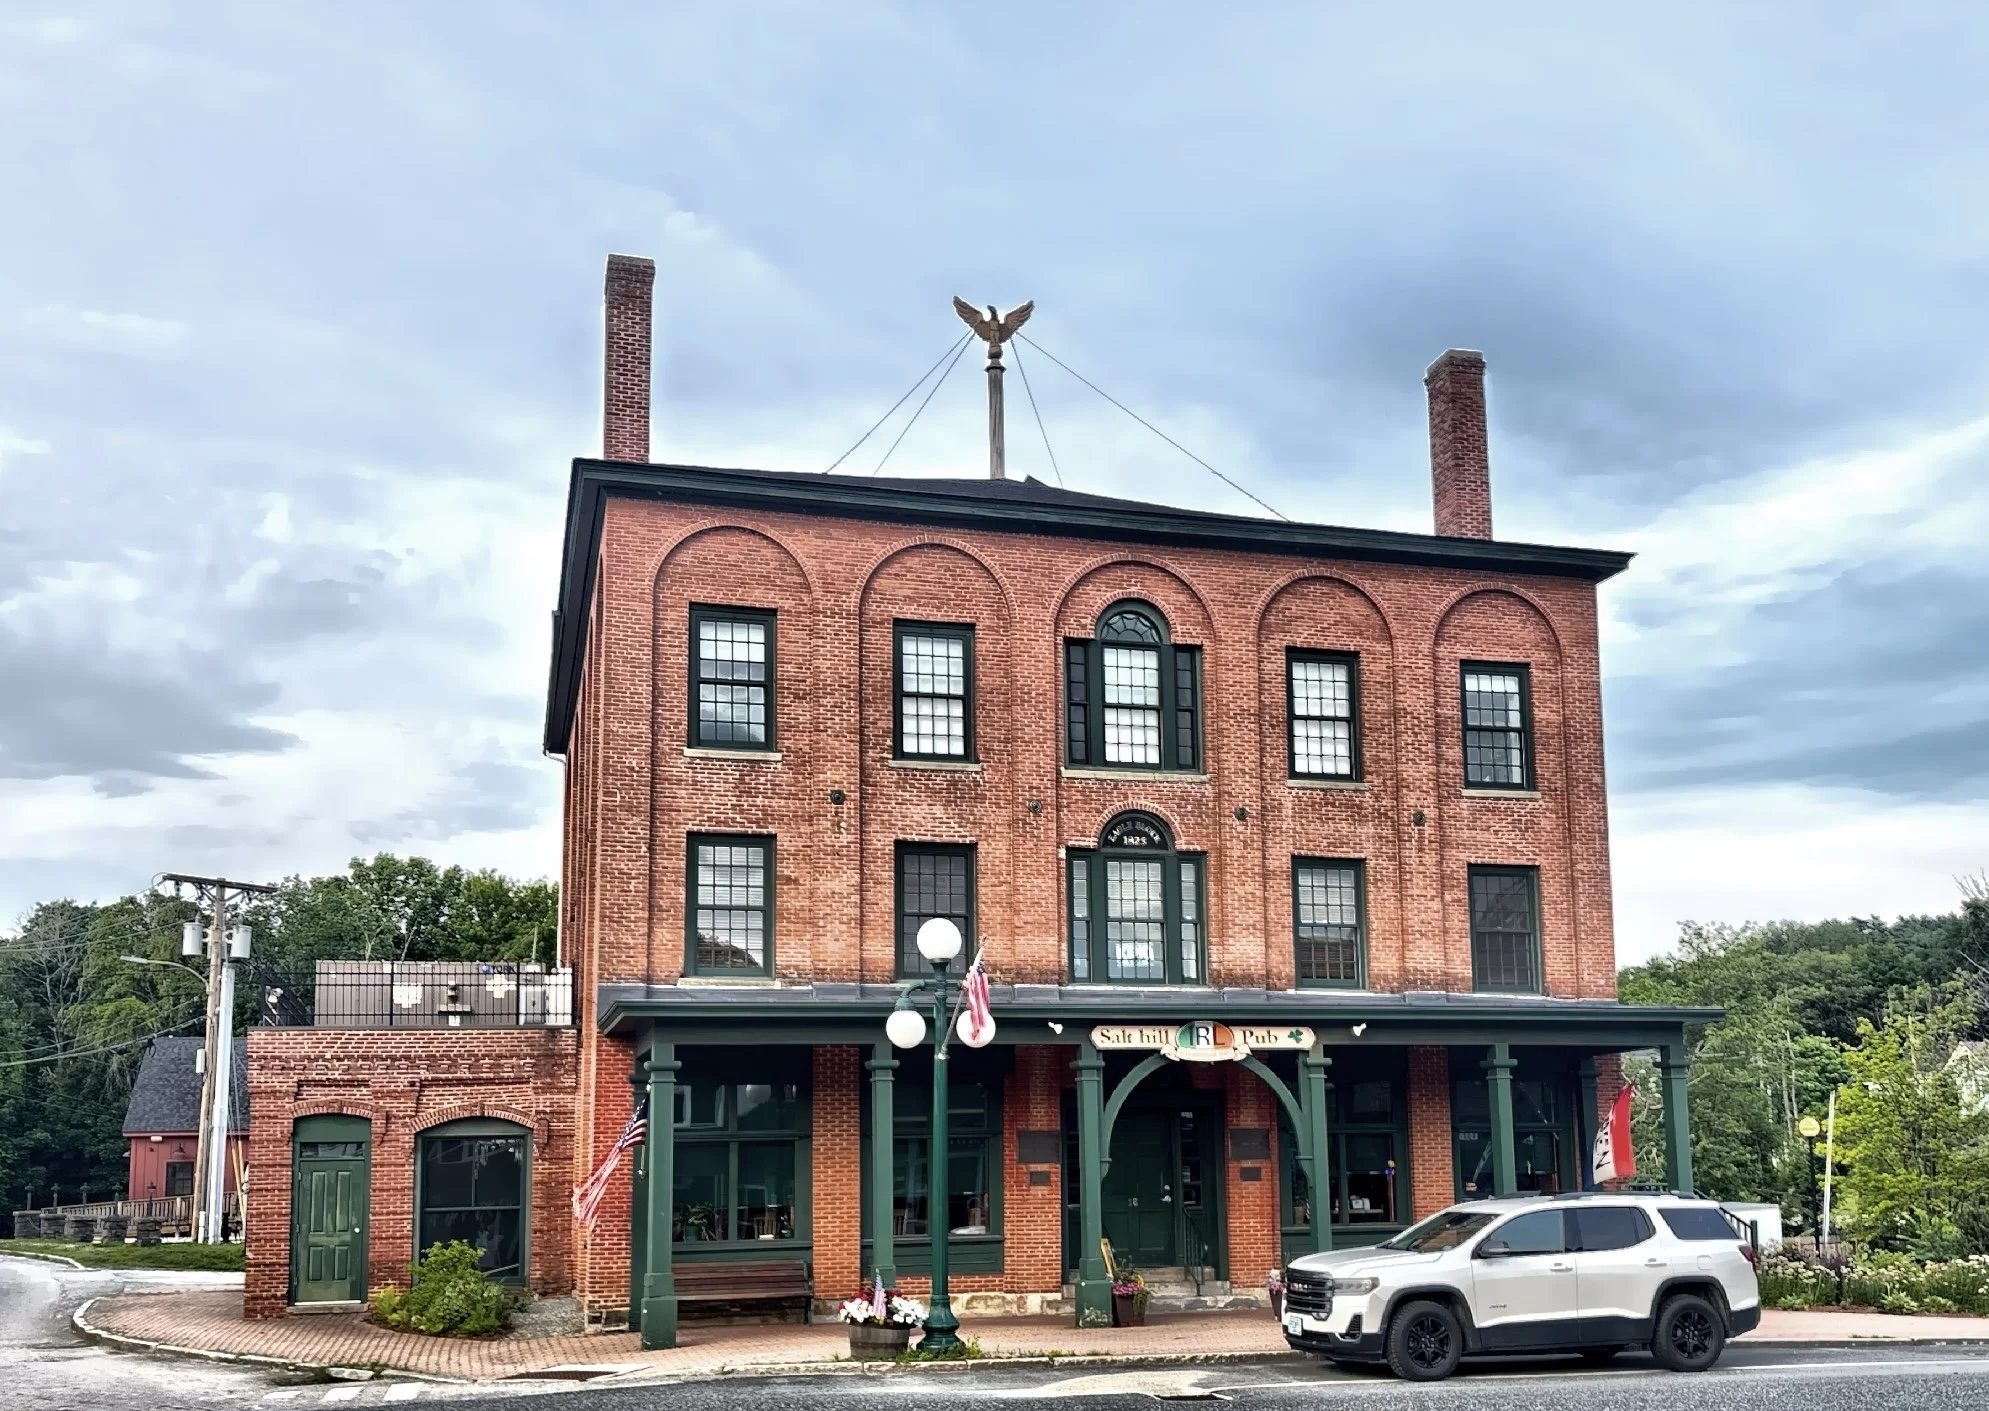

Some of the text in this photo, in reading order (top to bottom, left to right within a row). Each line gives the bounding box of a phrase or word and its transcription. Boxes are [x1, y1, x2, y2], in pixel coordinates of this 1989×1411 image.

[1123, 835, 1148, 846] 1825
[1100, 1028, 1278, 1044] Salt hill Pub
[1189, 1025, 1226, 1046] IRL
